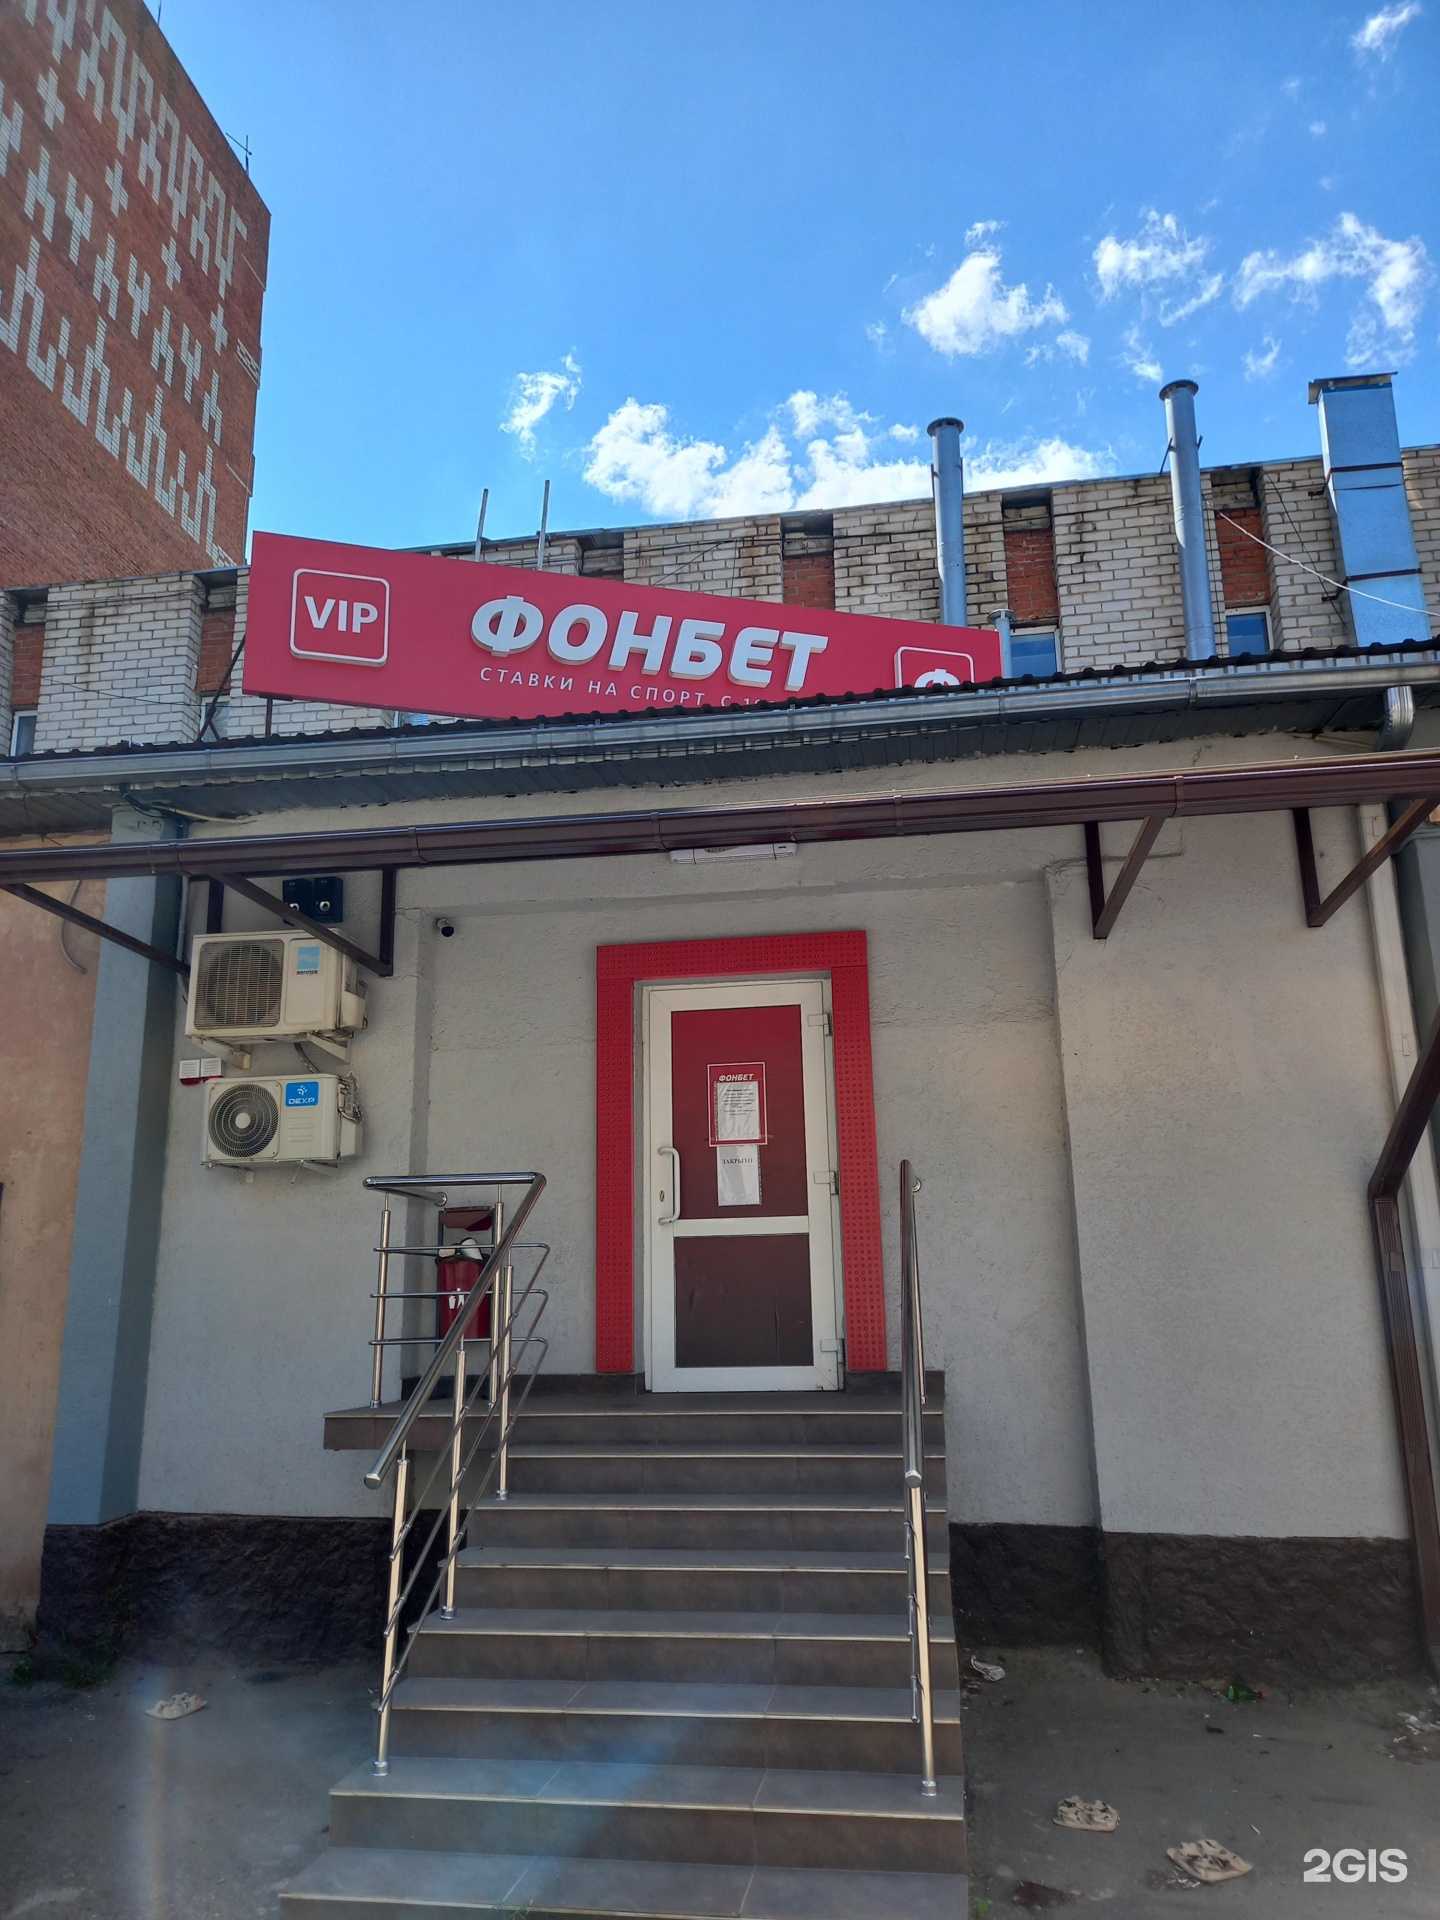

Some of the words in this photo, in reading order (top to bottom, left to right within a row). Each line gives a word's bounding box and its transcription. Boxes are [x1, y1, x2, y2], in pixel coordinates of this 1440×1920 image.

[304, 595, 379, 634] VIP
[471, 595, 829, 692] ФОНБЕТ
[480, 667, 574, 691] СТАВКИ
[588, 680, 617, 696] НА
[630, 685, 705, 706] СПОРТ
[718, 1073, 754, 1082] ФОНБЕТ
